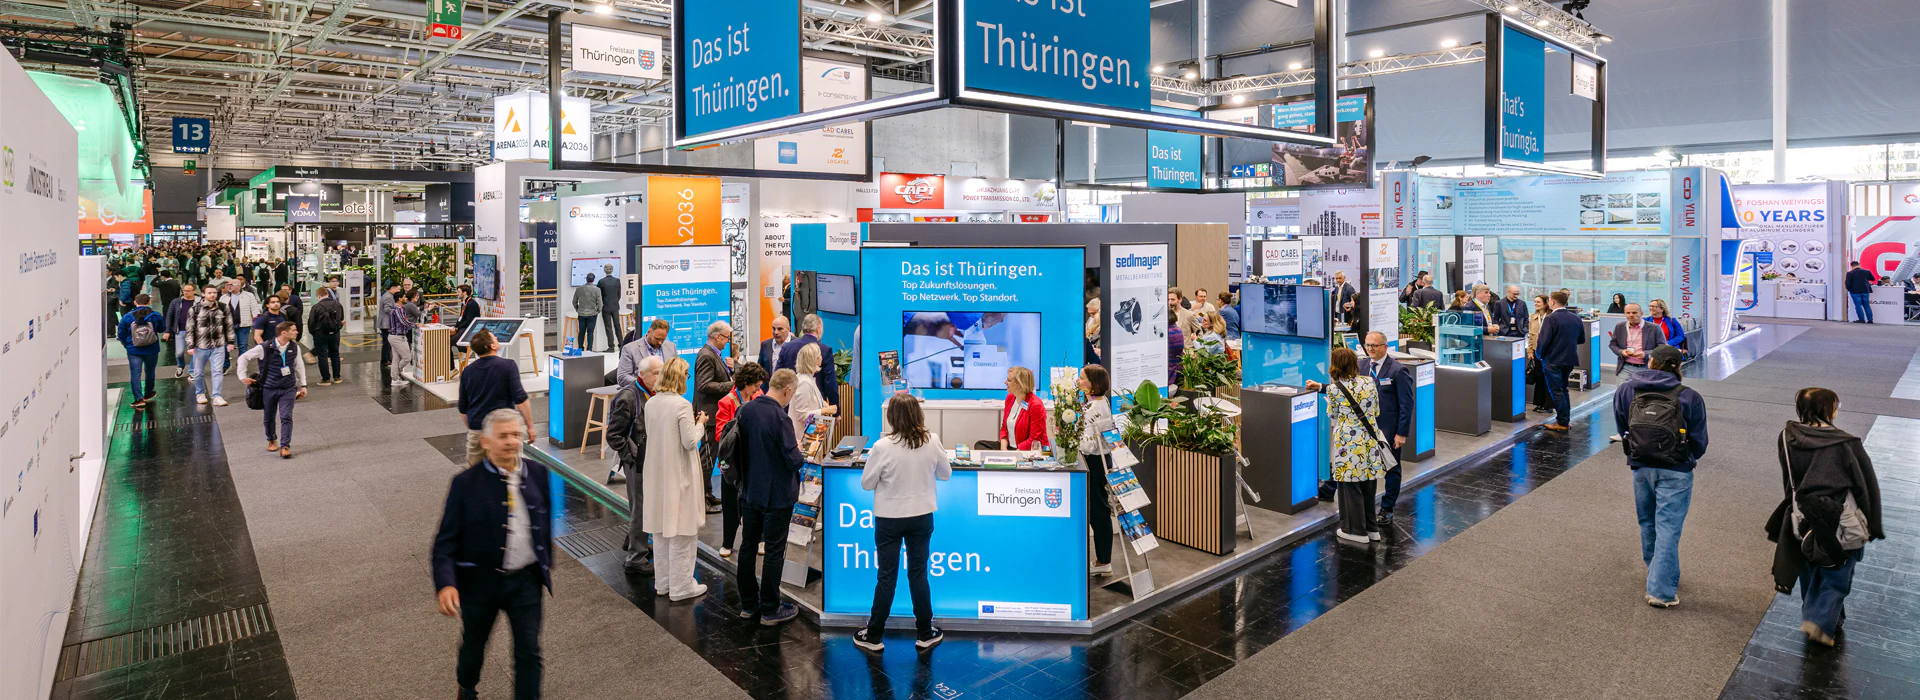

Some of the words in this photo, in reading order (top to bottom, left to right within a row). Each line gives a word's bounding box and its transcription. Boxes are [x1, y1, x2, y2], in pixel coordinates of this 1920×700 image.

[610, 46, 635, 54] Freistaat
[692, 38, 722, 68] Das
[728, 22, 750, 56] ist
[580, 48, 635, 66] Thüringen
[976, 21, 1140, 90] Thüringen.
[692, 72, 790, 116] Thüringen.
[179, 124, 204, 140] 13
[496, 140, 528, 150] ARENA2036
[1152, 146, 1168, 159] Das
[1171, 147, 1182, 160] ist
[1152, 166, 1197, 184] Thüringen.
[482, 190, 503, 200] ARENA2036
[894, 185, 936, 195] CAPT
[1686, 203, 1695, 227] YILIN
[1760, 210, 1825, 222] YEARS
[829, 236, 849, 245] Thüringen
[1266, 250, 1278, 258] CAD
[1280, 249, 1299, 258] CABEL
[1116, 254, 1162, 270] sedlmayer
[901, 261, 930, 276] Das
[935, 261, 954, 276] ist
[958, 261, 1042, 279] Thüringen.
[1116, 273, 1162, 281] METALLBEARBEITUNG
[628, 279, 634, 288] E
[902, 281, 917, 290] Top
[920, 281, 996, 291] Zukunftslösungen.
[682, 288, 717, 296] Thüringen.
[902, 293, 917, 302] Top
[920, 293, 961, 301] Netzwerk.
[962, 294, 978, 303] Top
[1294, 400, 1315, 411] sedlmayer
[986, 492, 1041, 507] Thüringen
[839, 503, 874, 528] Da
